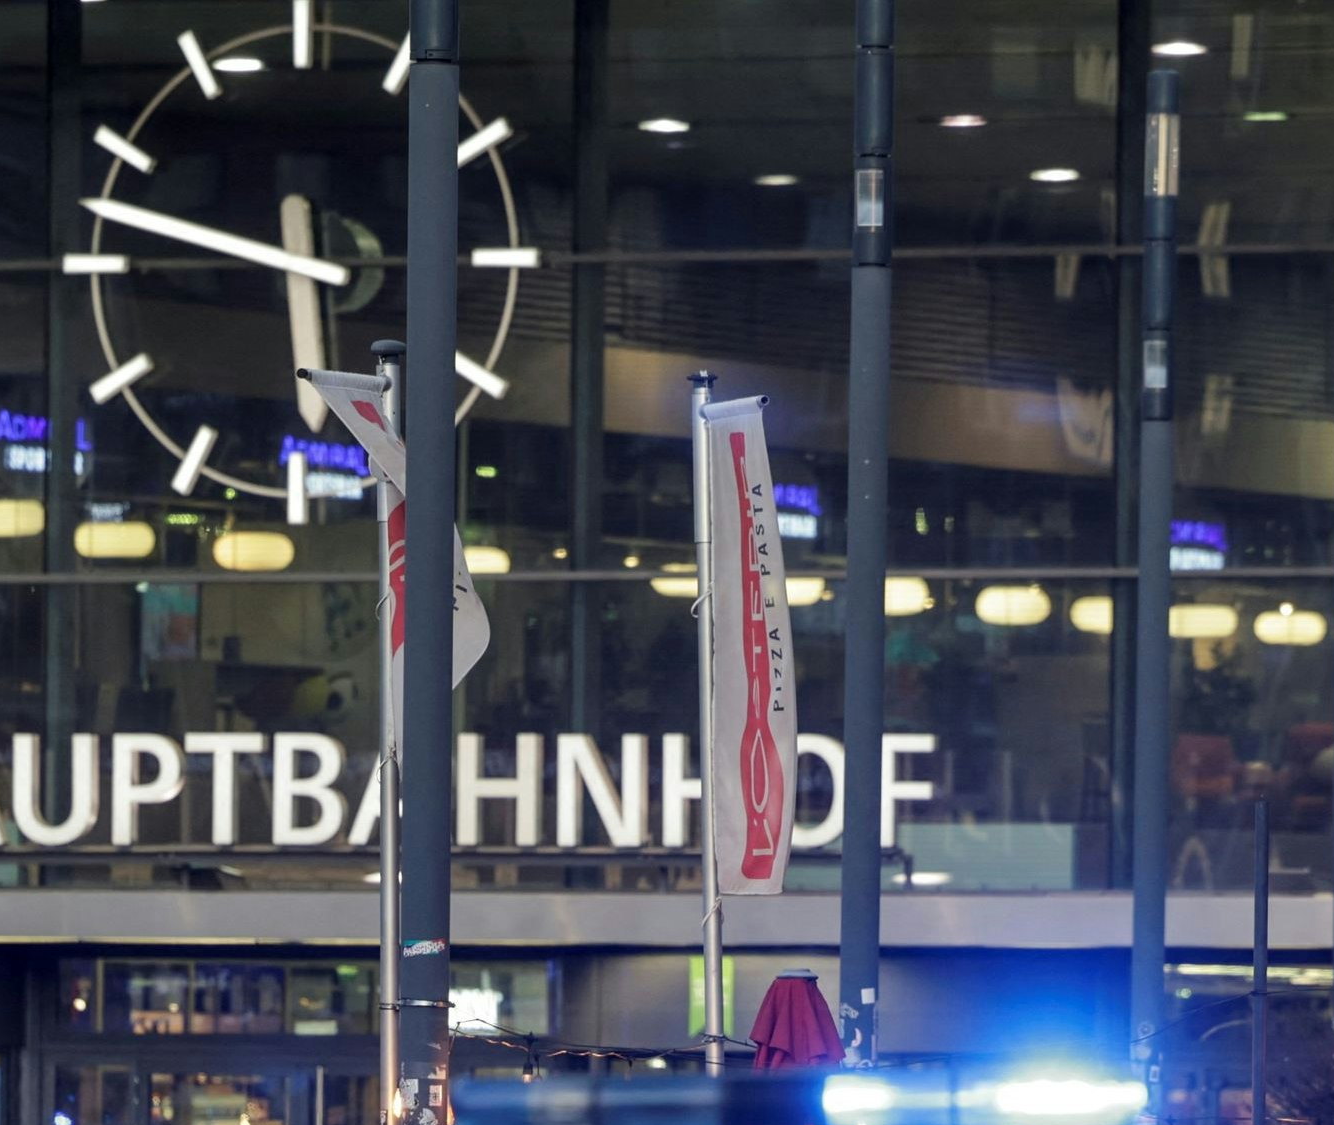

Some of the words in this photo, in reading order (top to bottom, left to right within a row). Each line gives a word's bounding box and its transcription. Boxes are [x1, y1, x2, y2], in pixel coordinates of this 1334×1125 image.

[751, 482, 770, 577] PASTA
[764, 596, 775, 609] E
[769, 627, 785, 713] PIZZA
